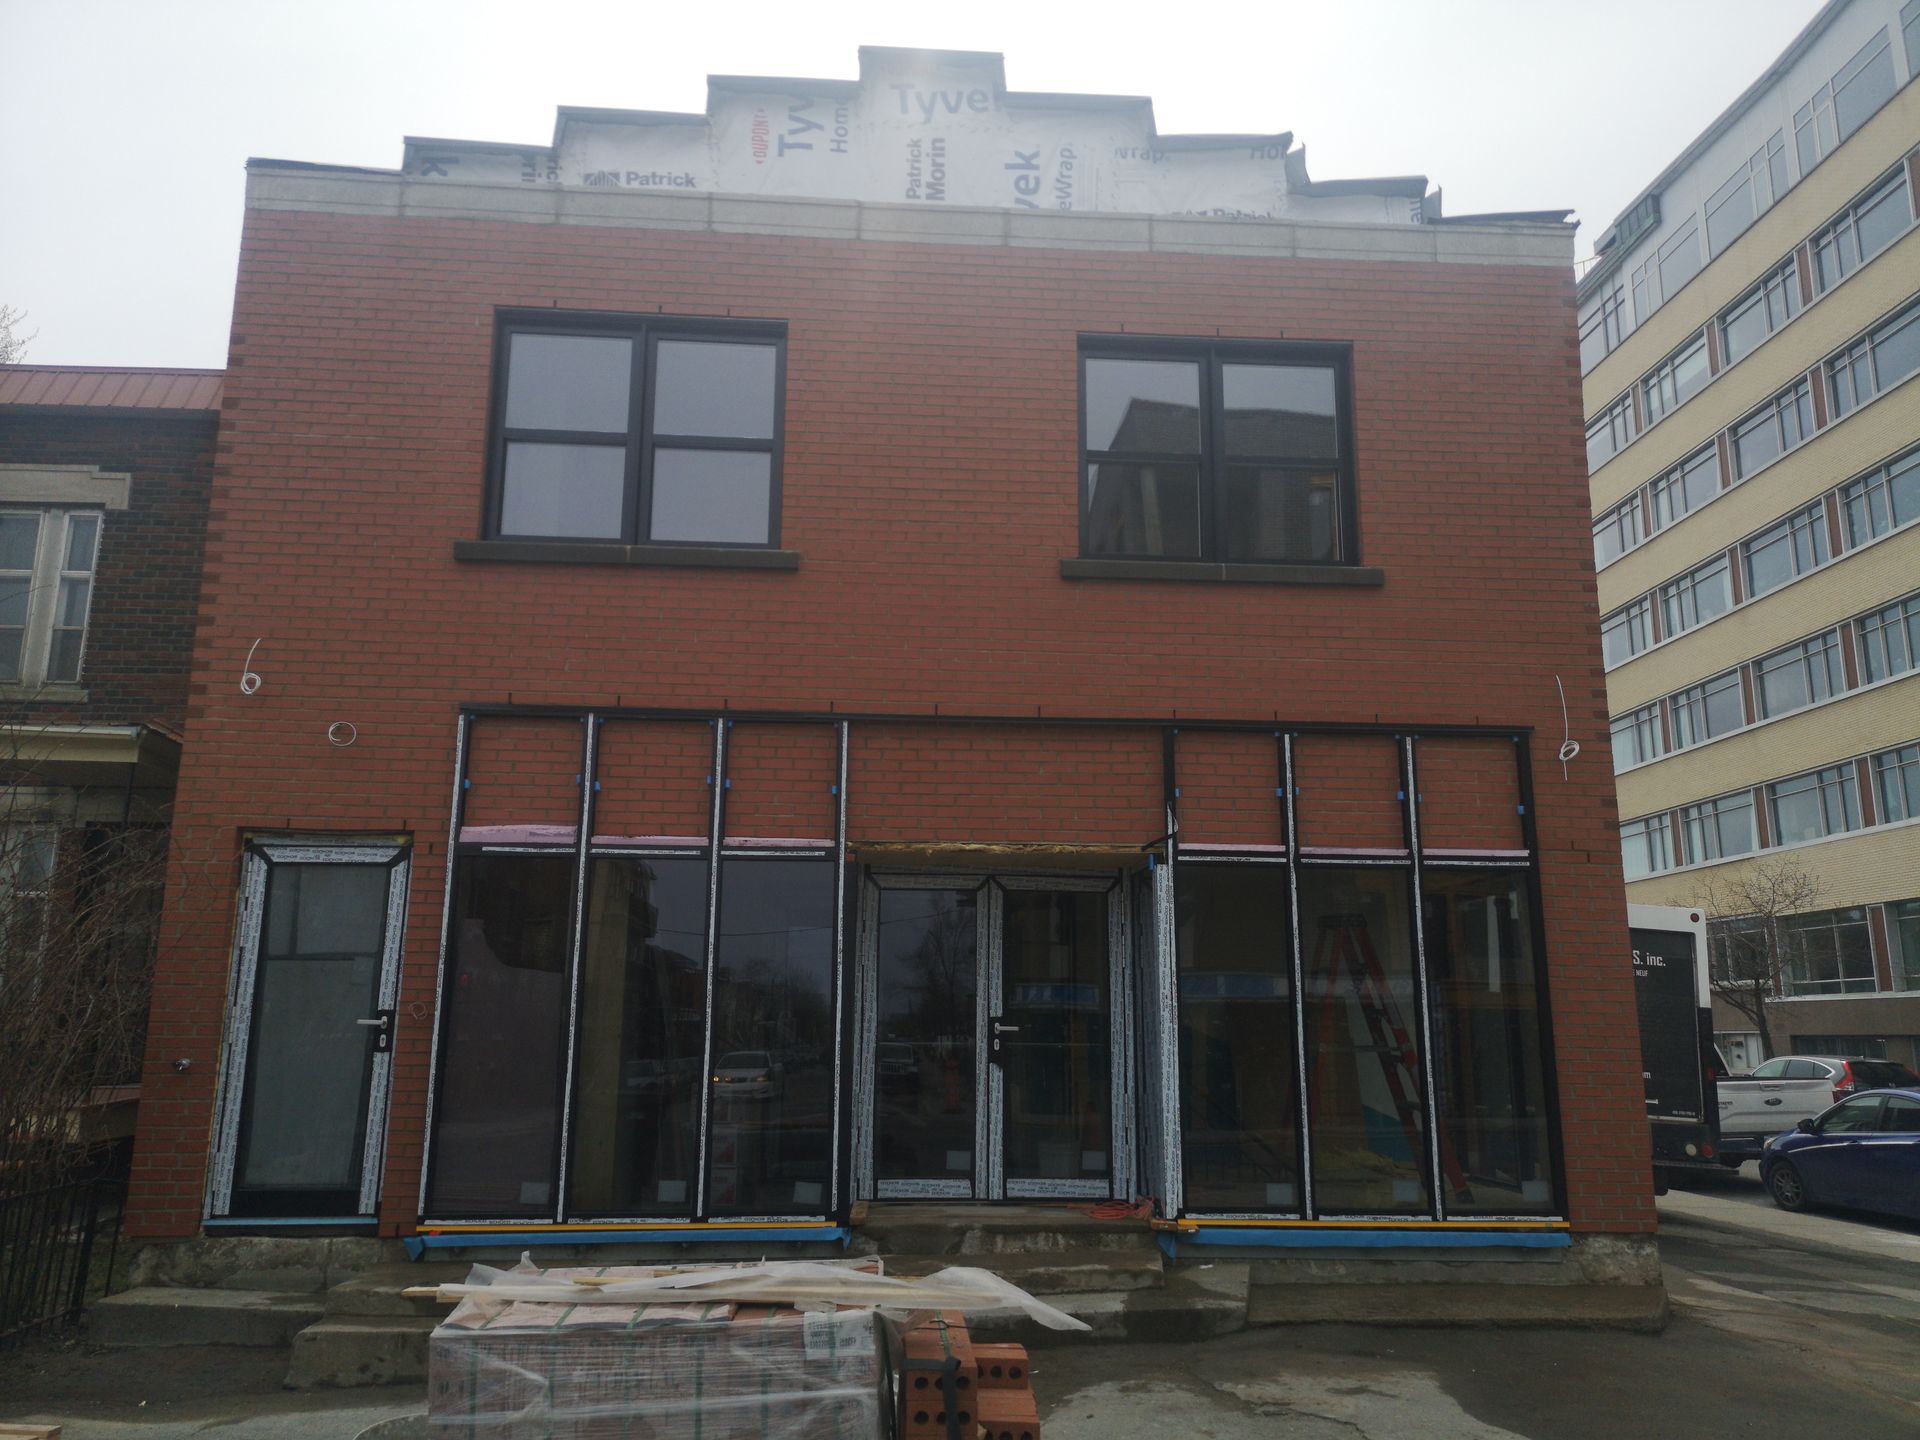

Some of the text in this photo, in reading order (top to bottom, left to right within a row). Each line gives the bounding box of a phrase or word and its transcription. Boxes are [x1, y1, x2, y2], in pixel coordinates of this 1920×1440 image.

[625, 171, 696, 188] Patrick
[906, 138, 921, 199] Patrick
[926, 138, 945, 200] Morin
[1646, 952, 1666, 967] inc.
